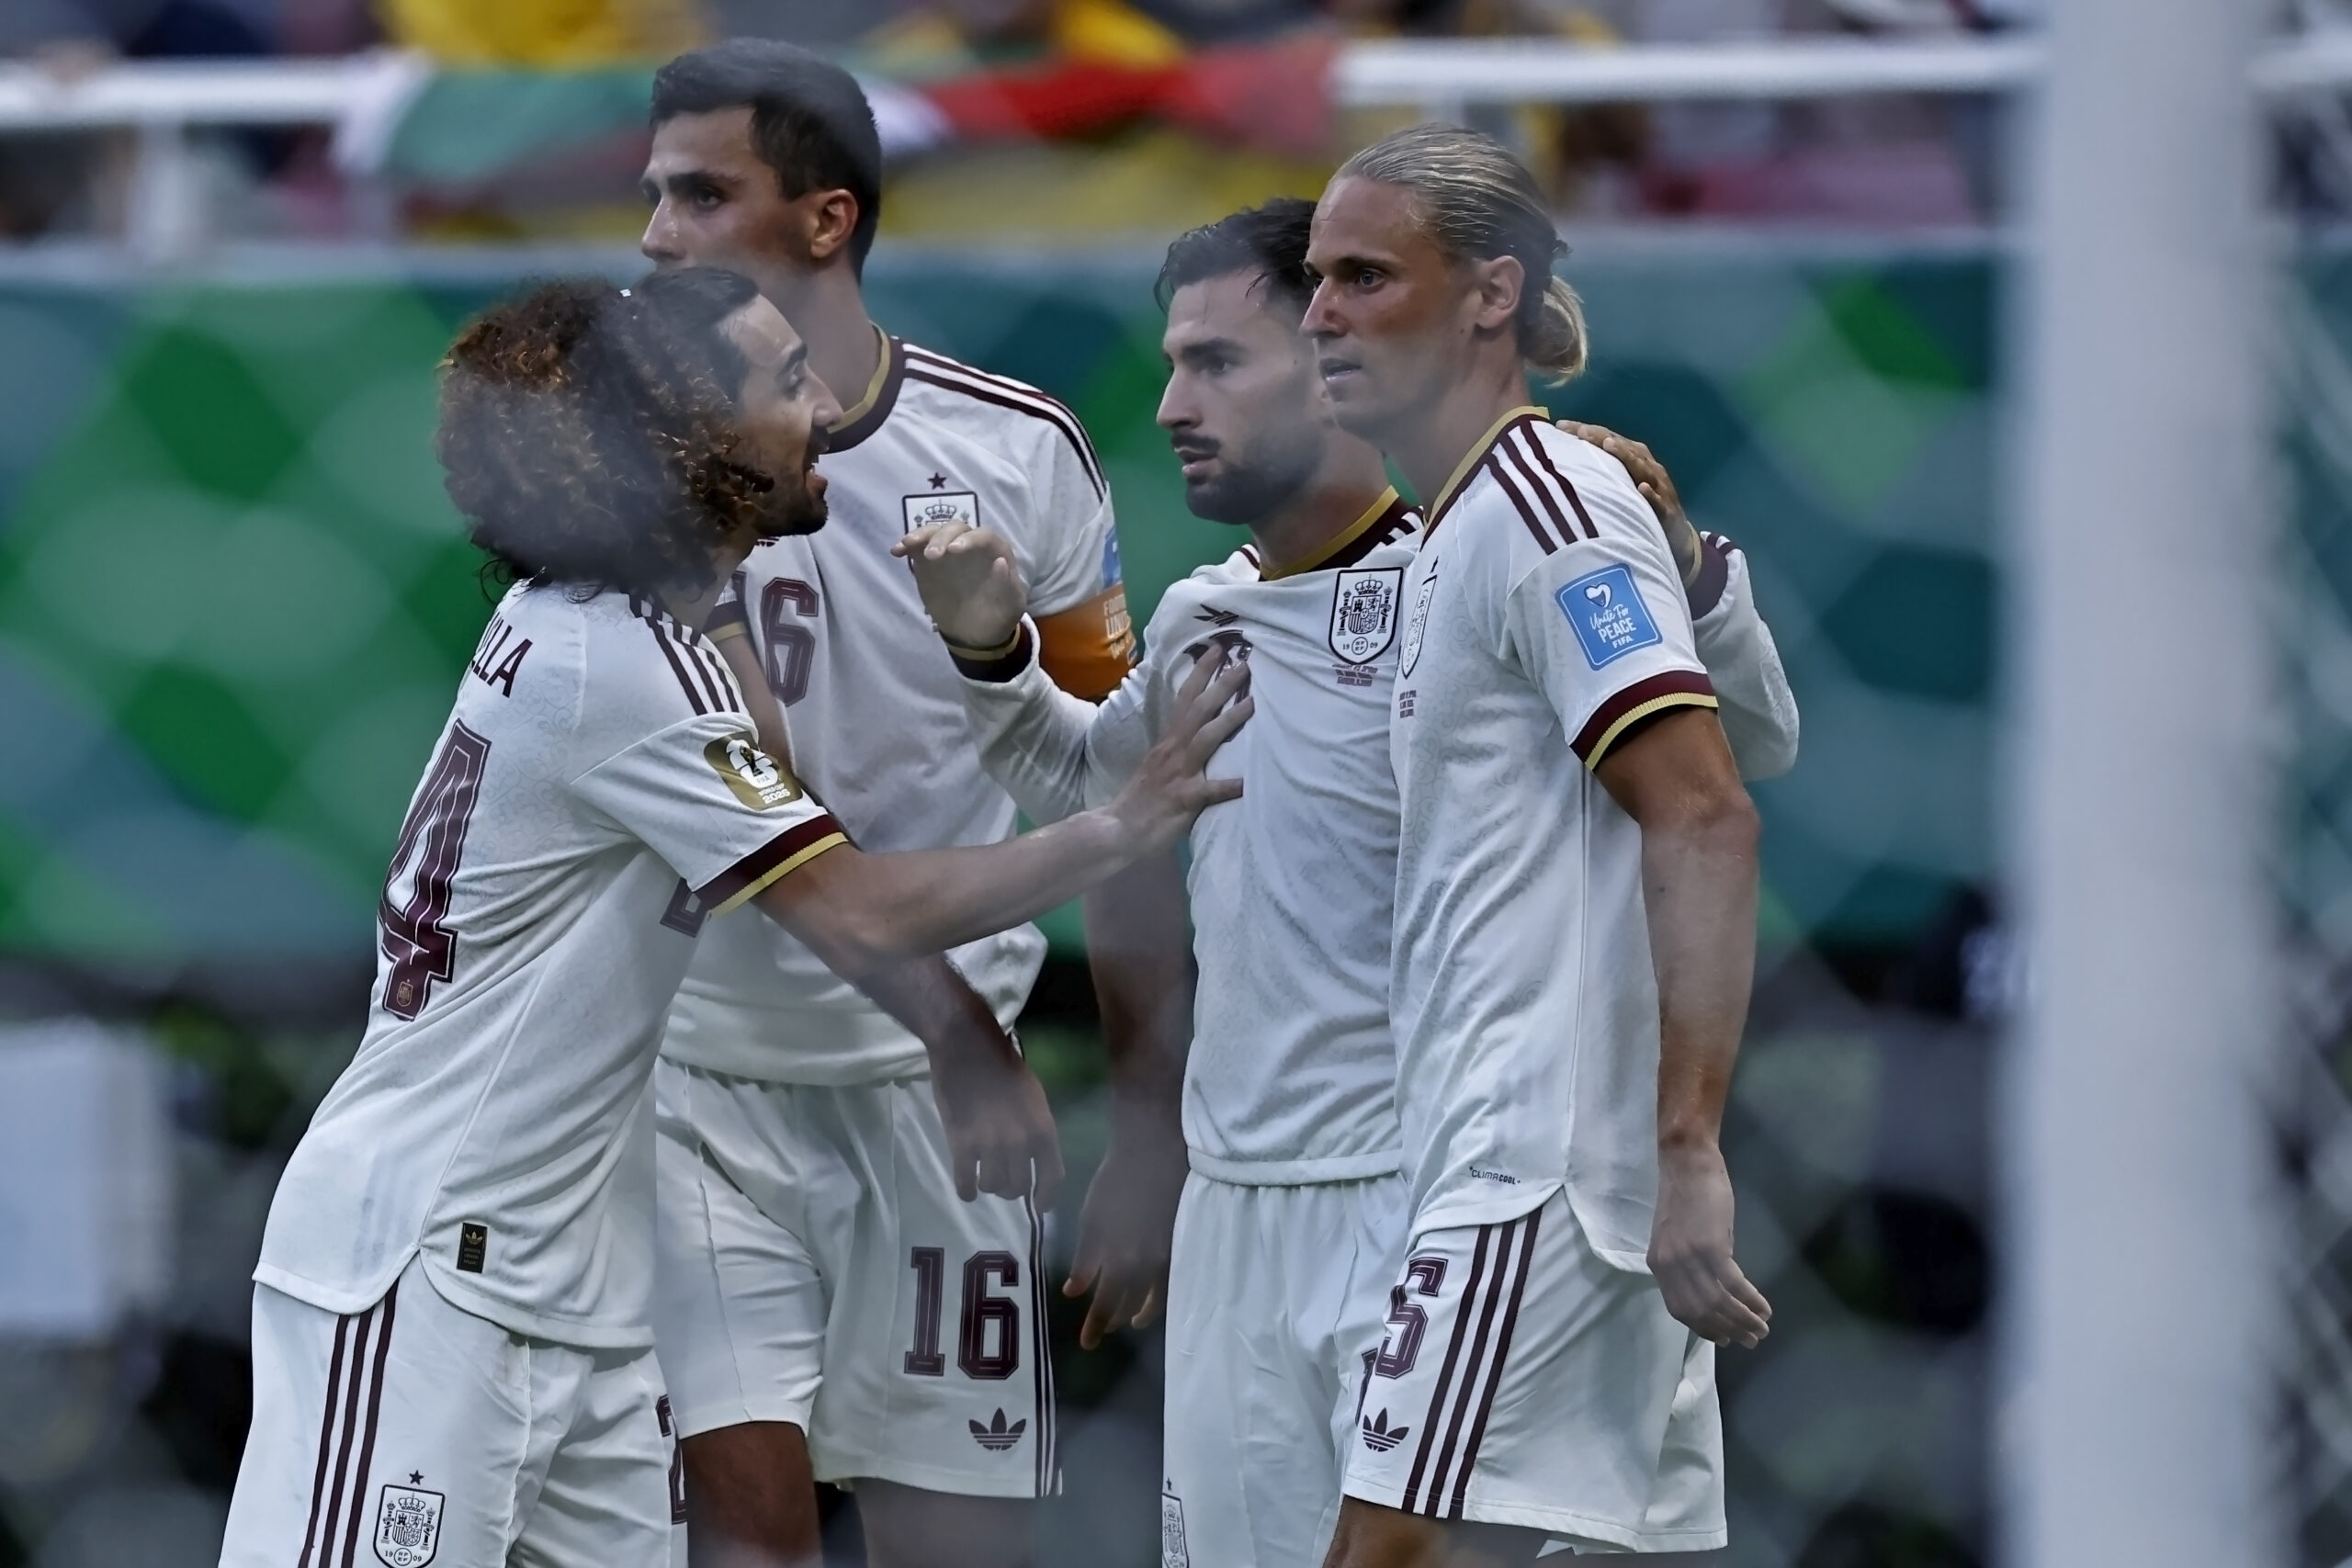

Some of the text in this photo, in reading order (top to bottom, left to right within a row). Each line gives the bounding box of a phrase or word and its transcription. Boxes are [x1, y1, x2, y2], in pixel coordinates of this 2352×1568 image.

[1589, 604, 1630, 630] Unite For
[732, 570, 820, 707] 6
[1599, 617, 1637, 644] PEACE
[1612, 635, 1634, 649] FIFA
[763, 788, 791, 805] 2026
[903, 1247, 1019, 1380] 16
[385, 1550, 422, 1562] 19 09
